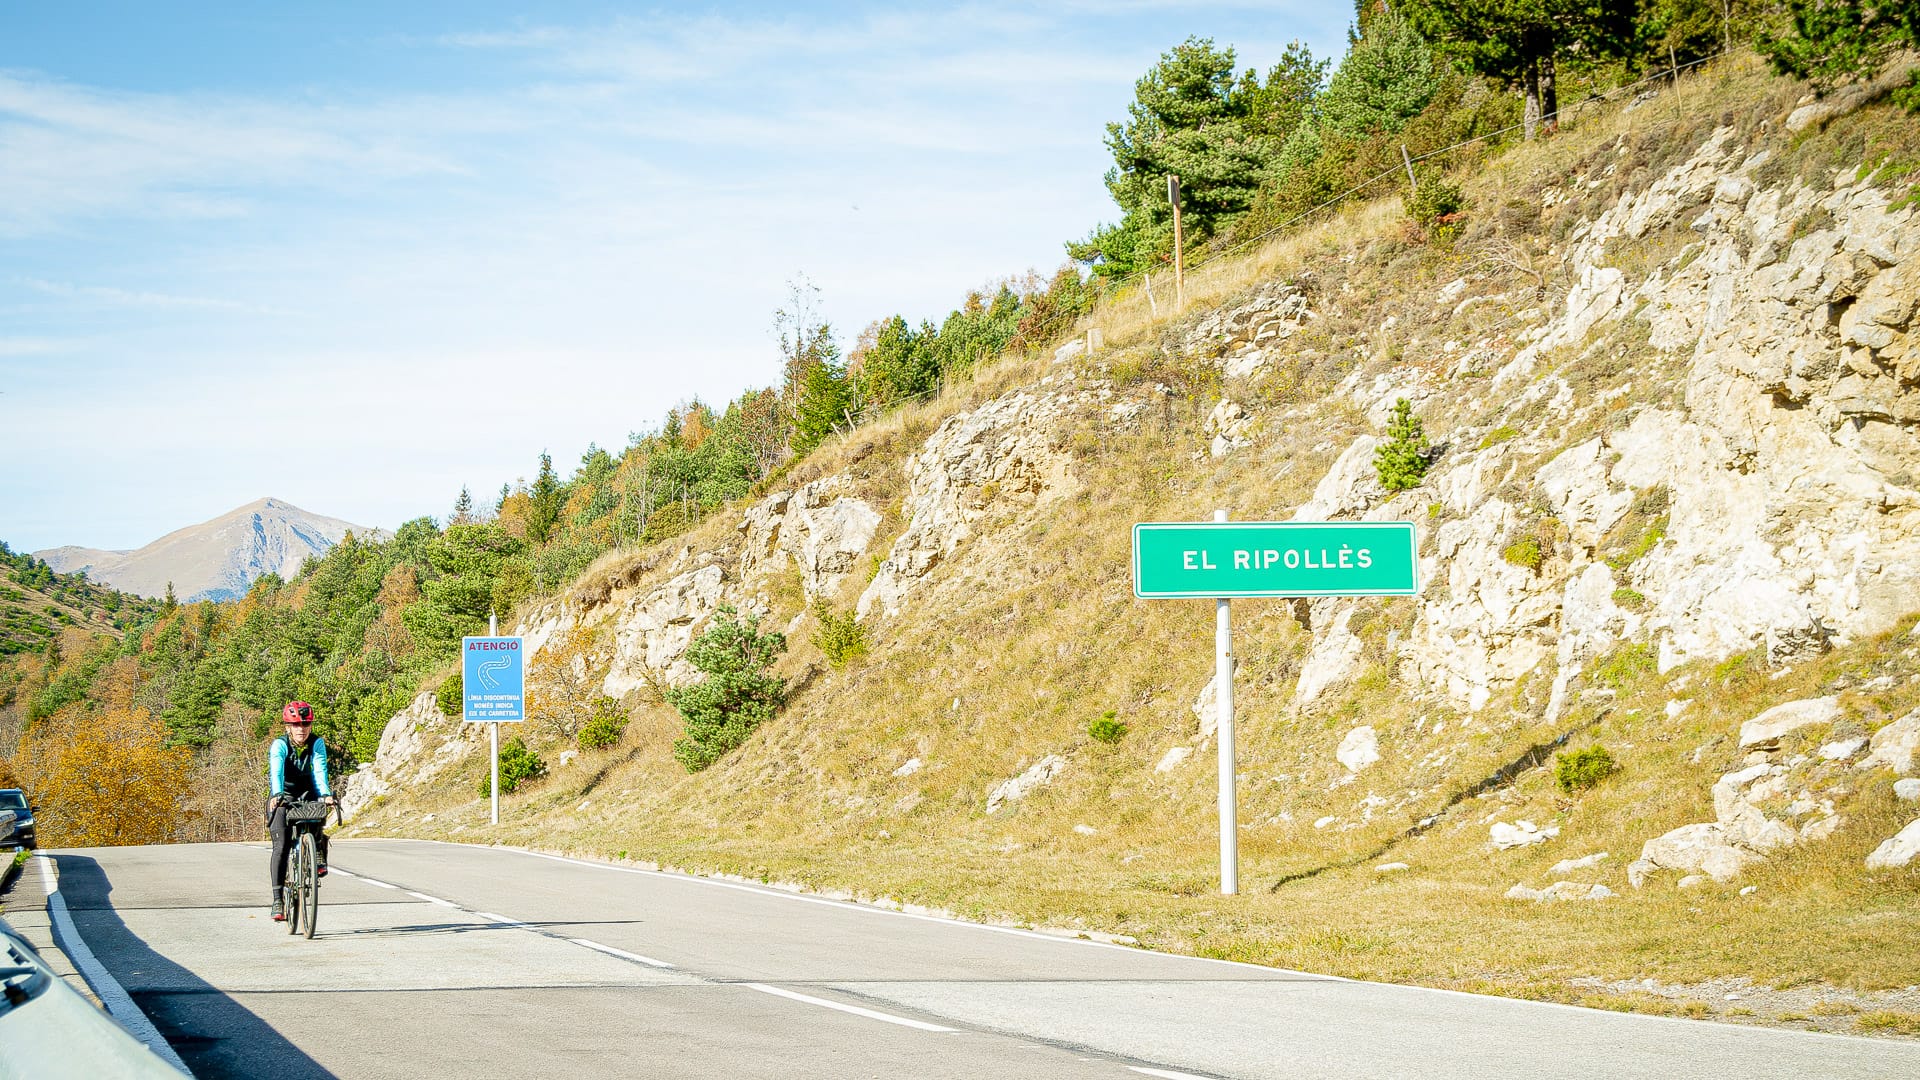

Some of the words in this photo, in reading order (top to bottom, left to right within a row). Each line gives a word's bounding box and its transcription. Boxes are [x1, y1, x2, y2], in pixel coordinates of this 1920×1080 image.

[1183, 550, 1217, 570] EL
[1234, 543, 1373, 570] RIPOLLÈS
[469, 640, 518, 651] ATENCIÓ
